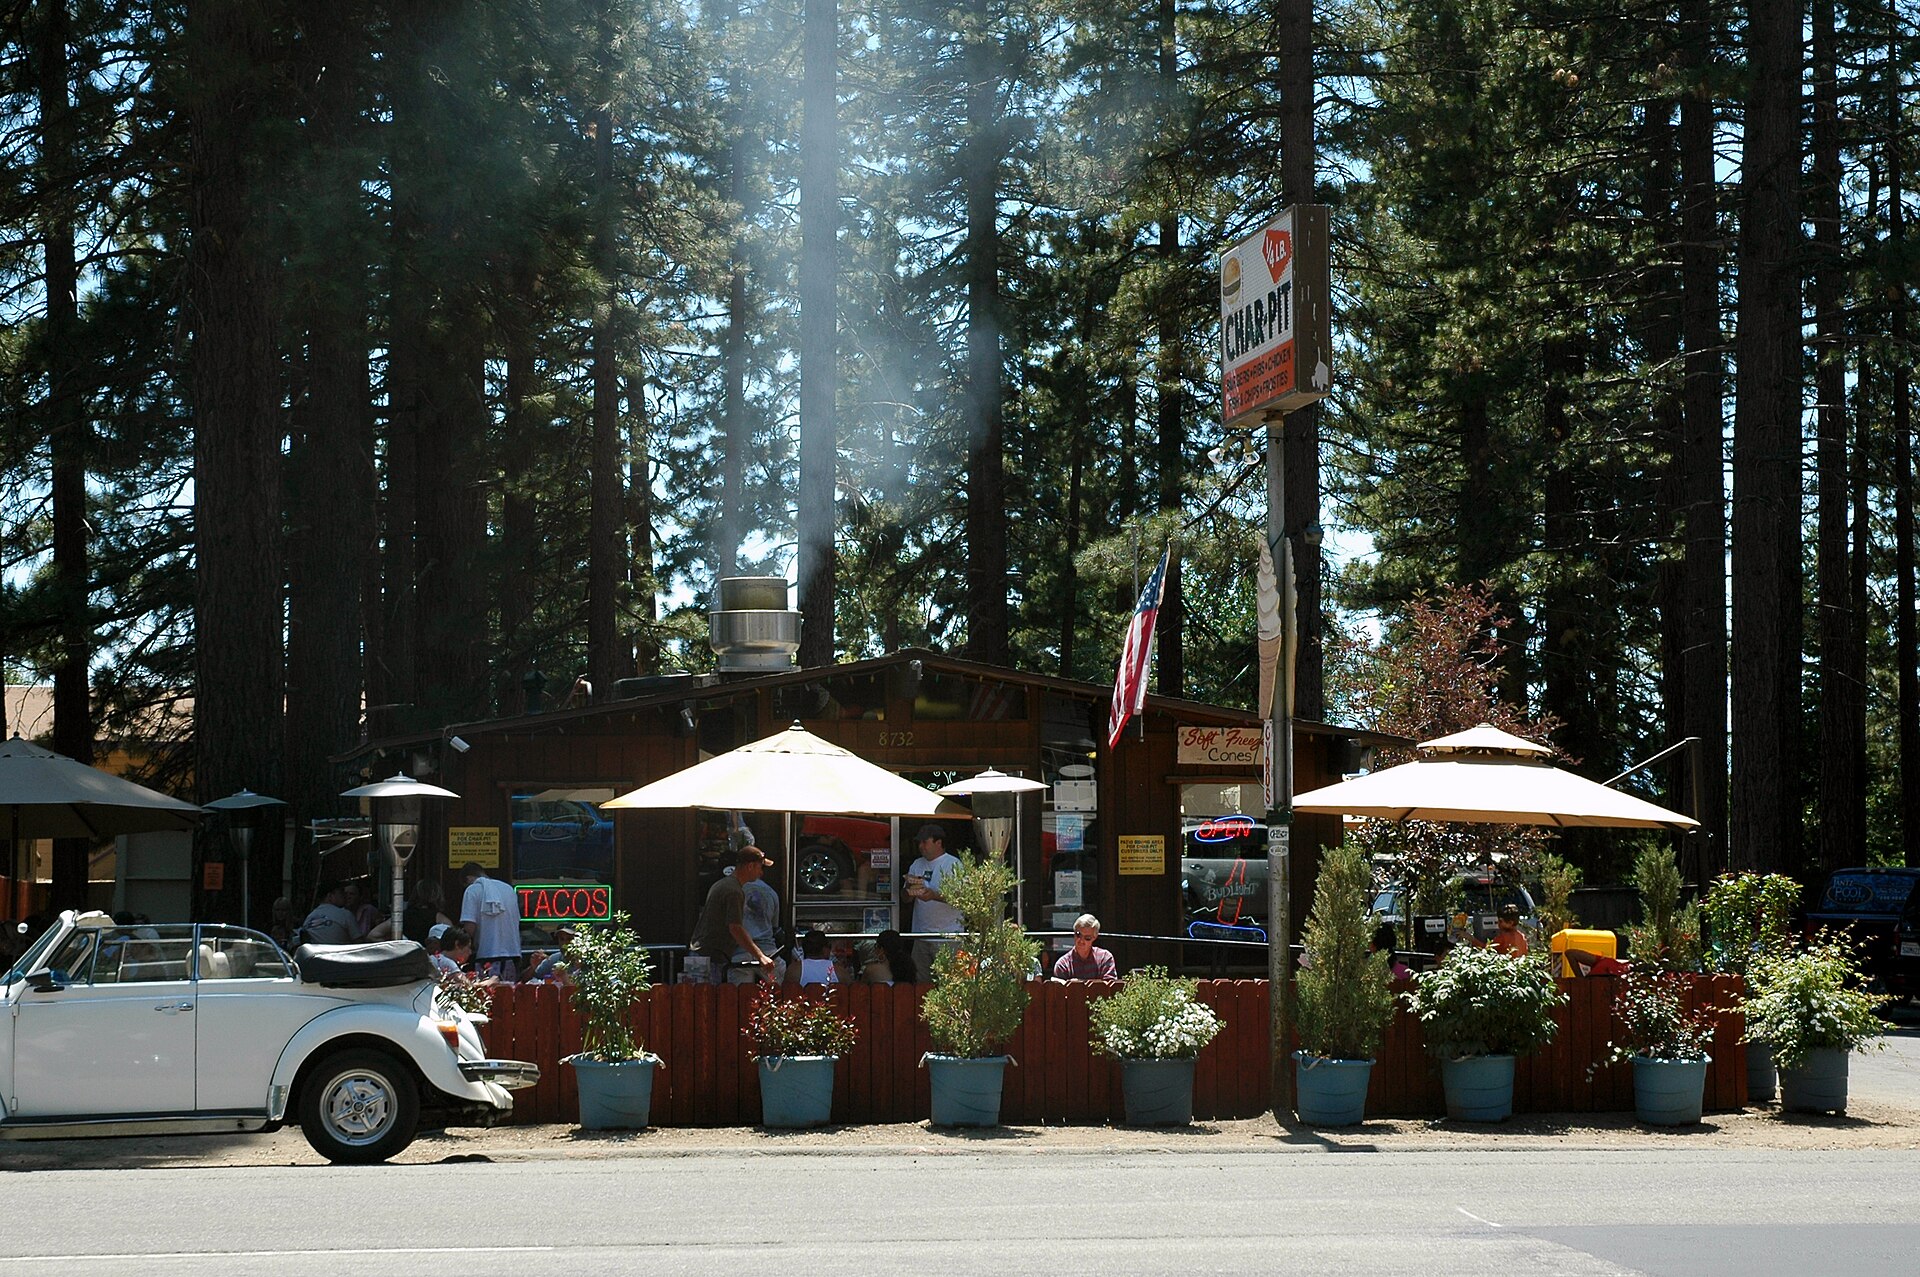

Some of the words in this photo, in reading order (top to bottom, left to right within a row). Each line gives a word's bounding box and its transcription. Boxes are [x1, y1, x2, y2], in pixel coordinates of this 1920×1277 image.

[1267, 346, 1291, 371] CHICKEN
[1263, 370, 1288, 394] FROSTIES
[878, 731, 914, 746] 8732
[1184, 728, 1220, 751] Soft
[1208, 748, 1252, 762] Cones
[1199, 821, 1252, 838] OPEN
[518, 888, 608, 917] TACOS
[1835, 887, 1864, 898] POOL
